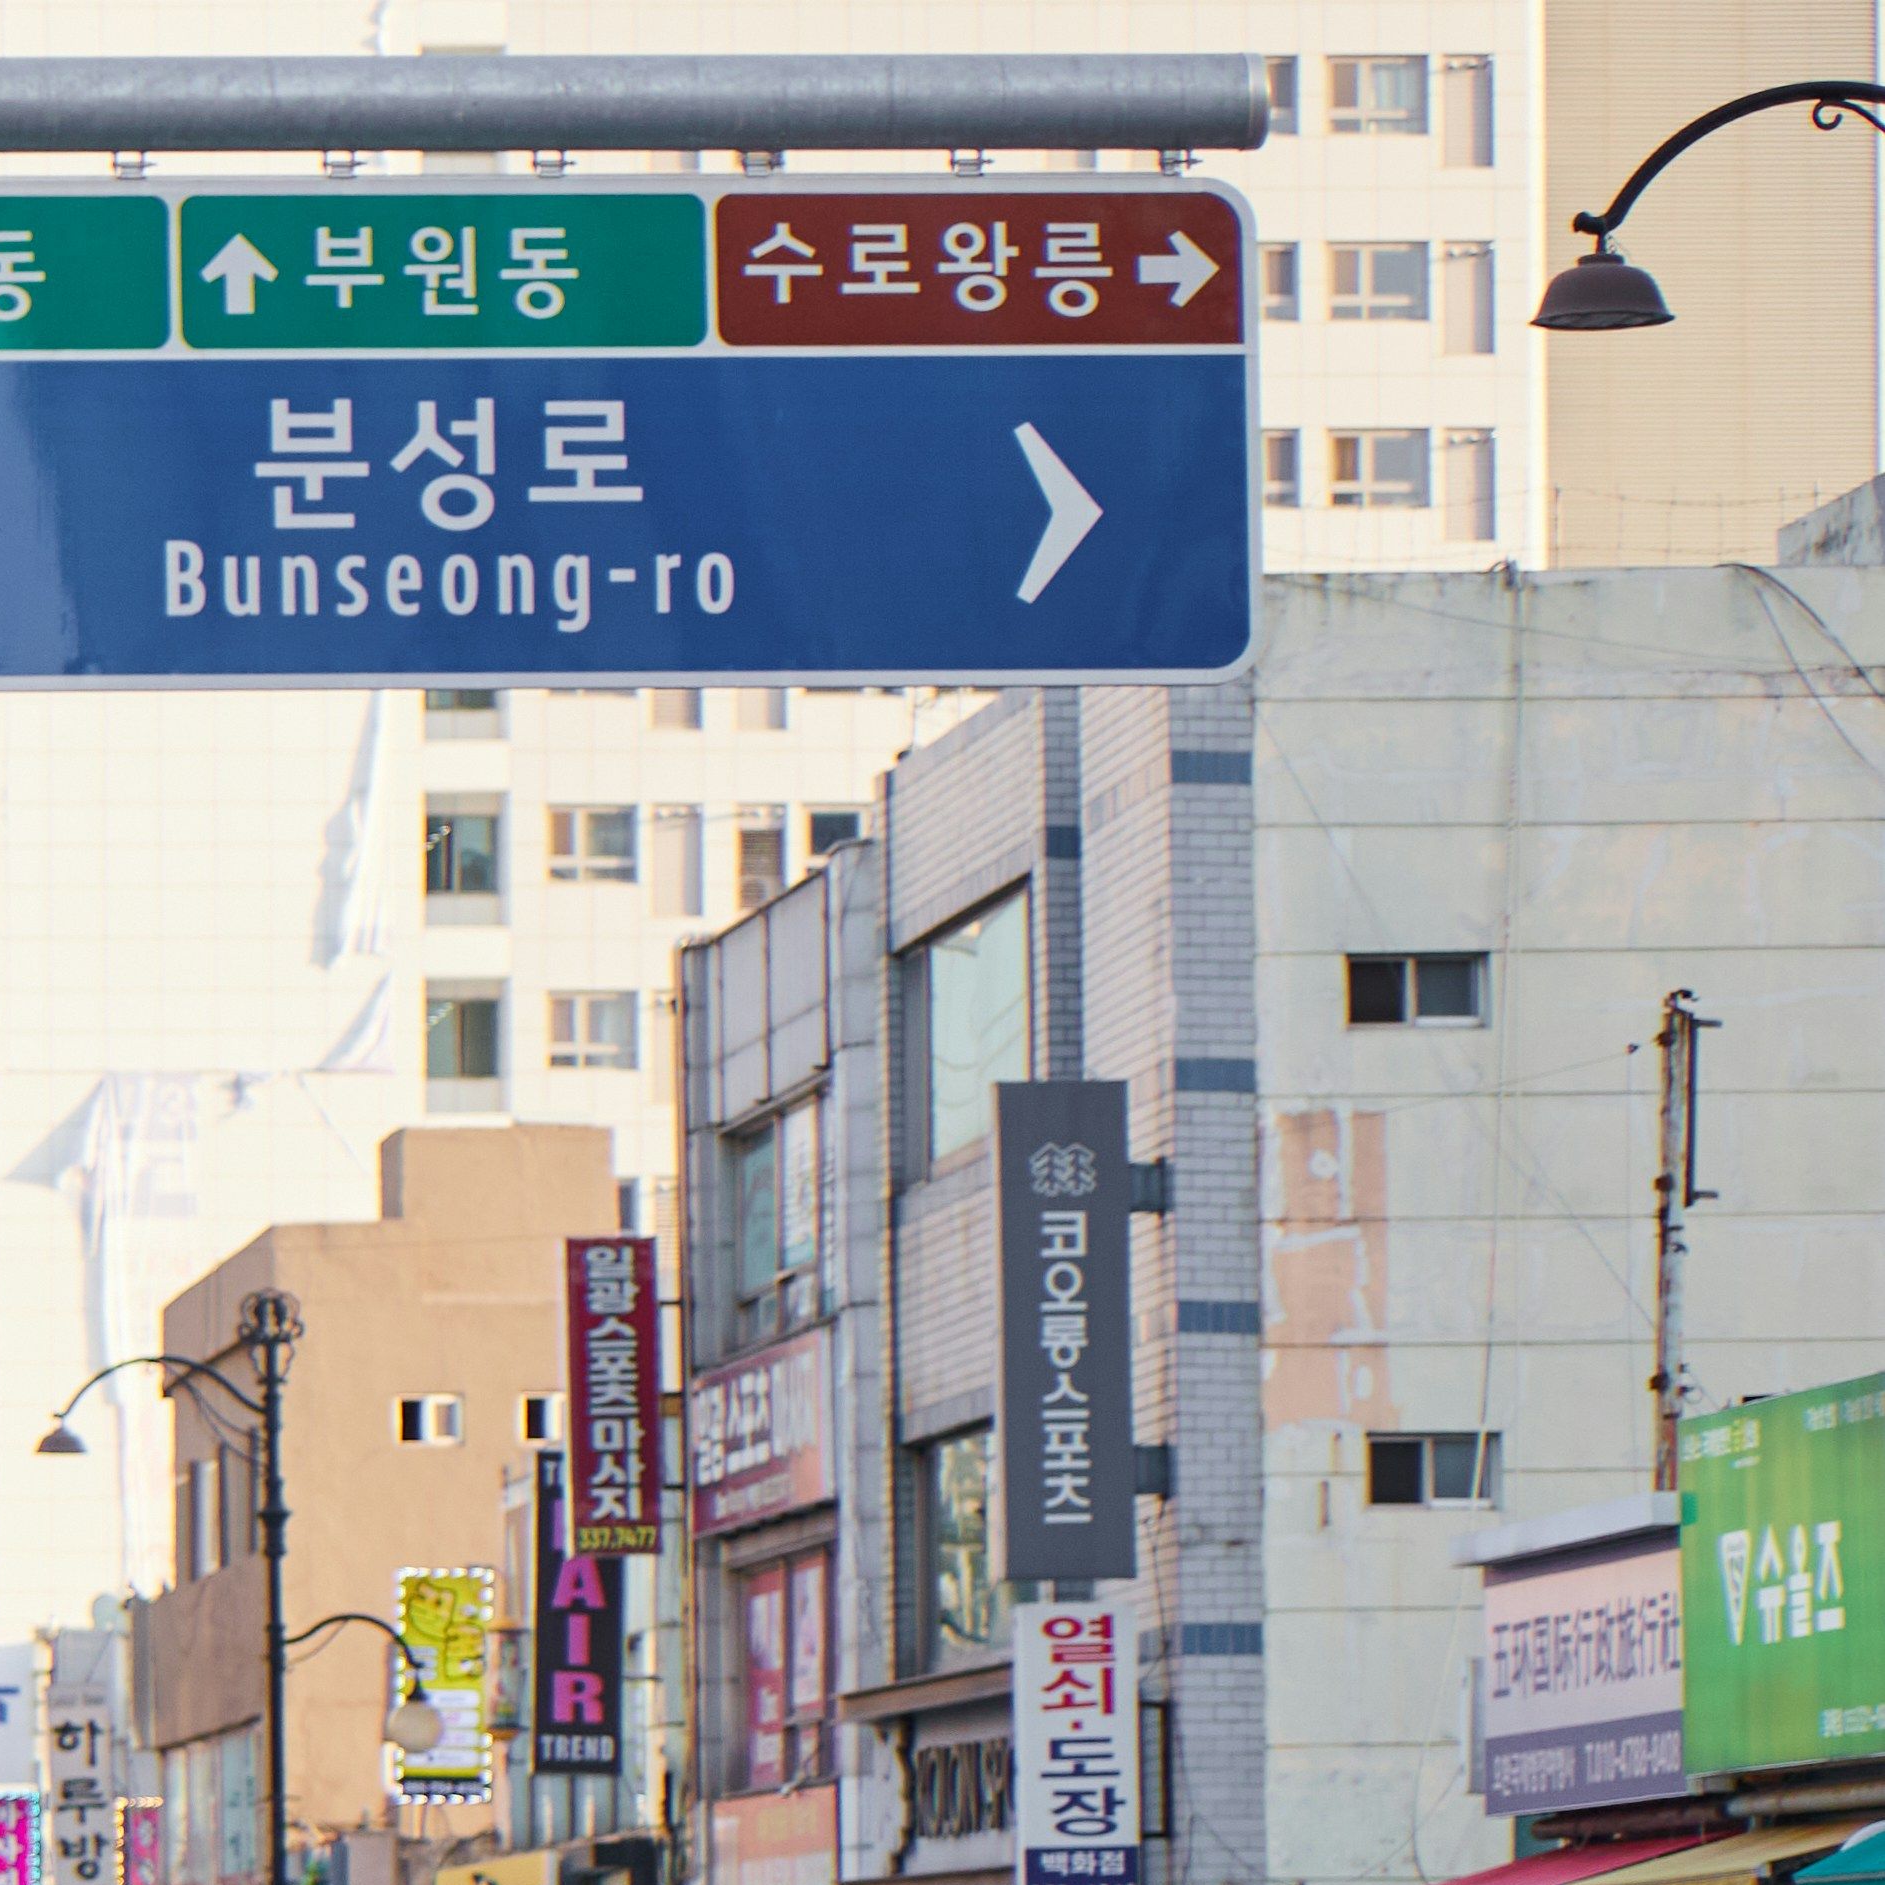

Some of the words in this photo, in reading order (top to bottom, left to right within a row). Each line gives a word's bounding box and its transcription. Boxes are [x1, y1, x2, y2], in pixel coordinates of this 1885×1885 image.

[304, 224, 579, 319] 부원동
[744, 221, 1114, 318] 수로왕릉
[255, 397, 644, 532] 분성로
[166, 540, 736, 633] Bunseong-ro
[1040, 1210, 1093, 1524] 코오롱스포츠
[552, 1500, 606, 1724] AIR
[1756, 1521, 1846, 1645] 슈올즈
[540, 1733, 616, 1764] TREND
[1041, 1851, 1126, 1877] 백화점
